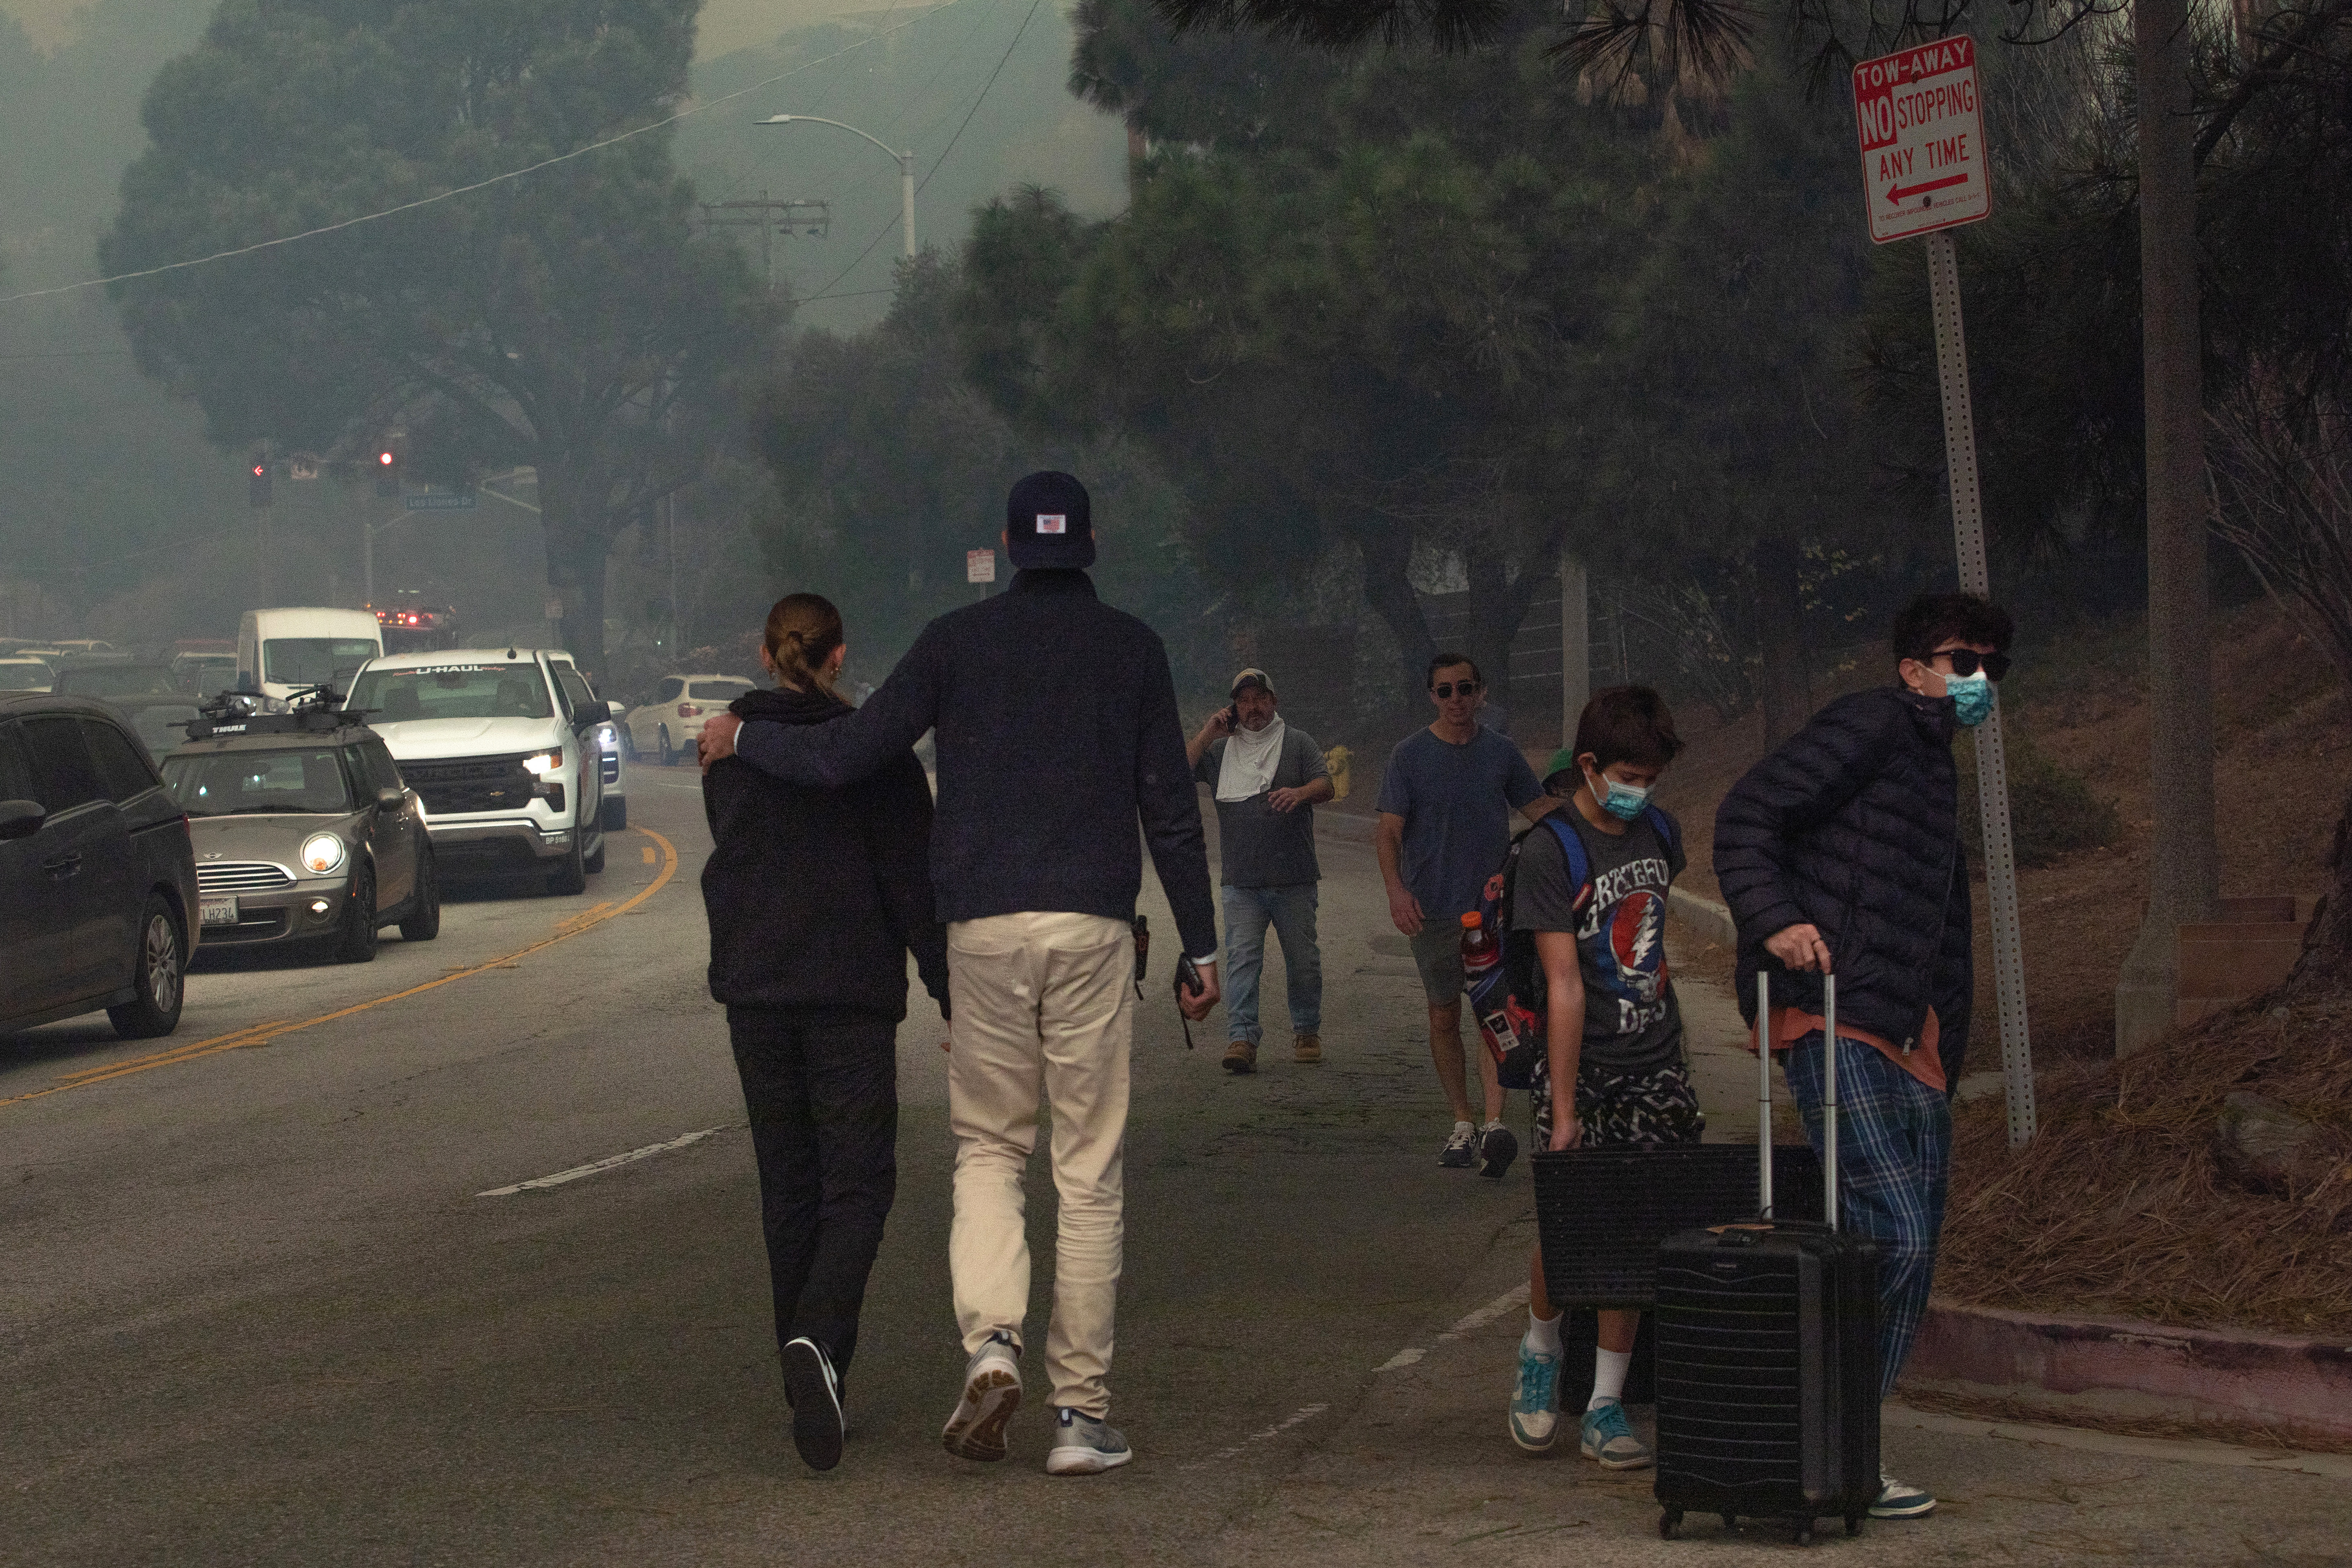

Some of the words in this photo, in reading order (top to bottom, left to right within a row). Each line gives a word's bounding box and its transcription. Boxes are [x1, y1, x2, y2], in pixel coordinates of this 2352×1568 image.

[1857, 40, 1968, 90] TOW-AWAY
[1860, 96, 1893, 145] NO
[1897, 79, 1973, 129] STOPPING
[1880, 147, 1913, 182] ANY
[1925, 134, 1969, 169] TIME
[417, 665, 484, 675] U-HAUL
[212, 724, 246, 733] THULE
[1577, 858, 1669, 940] GRATEFU
